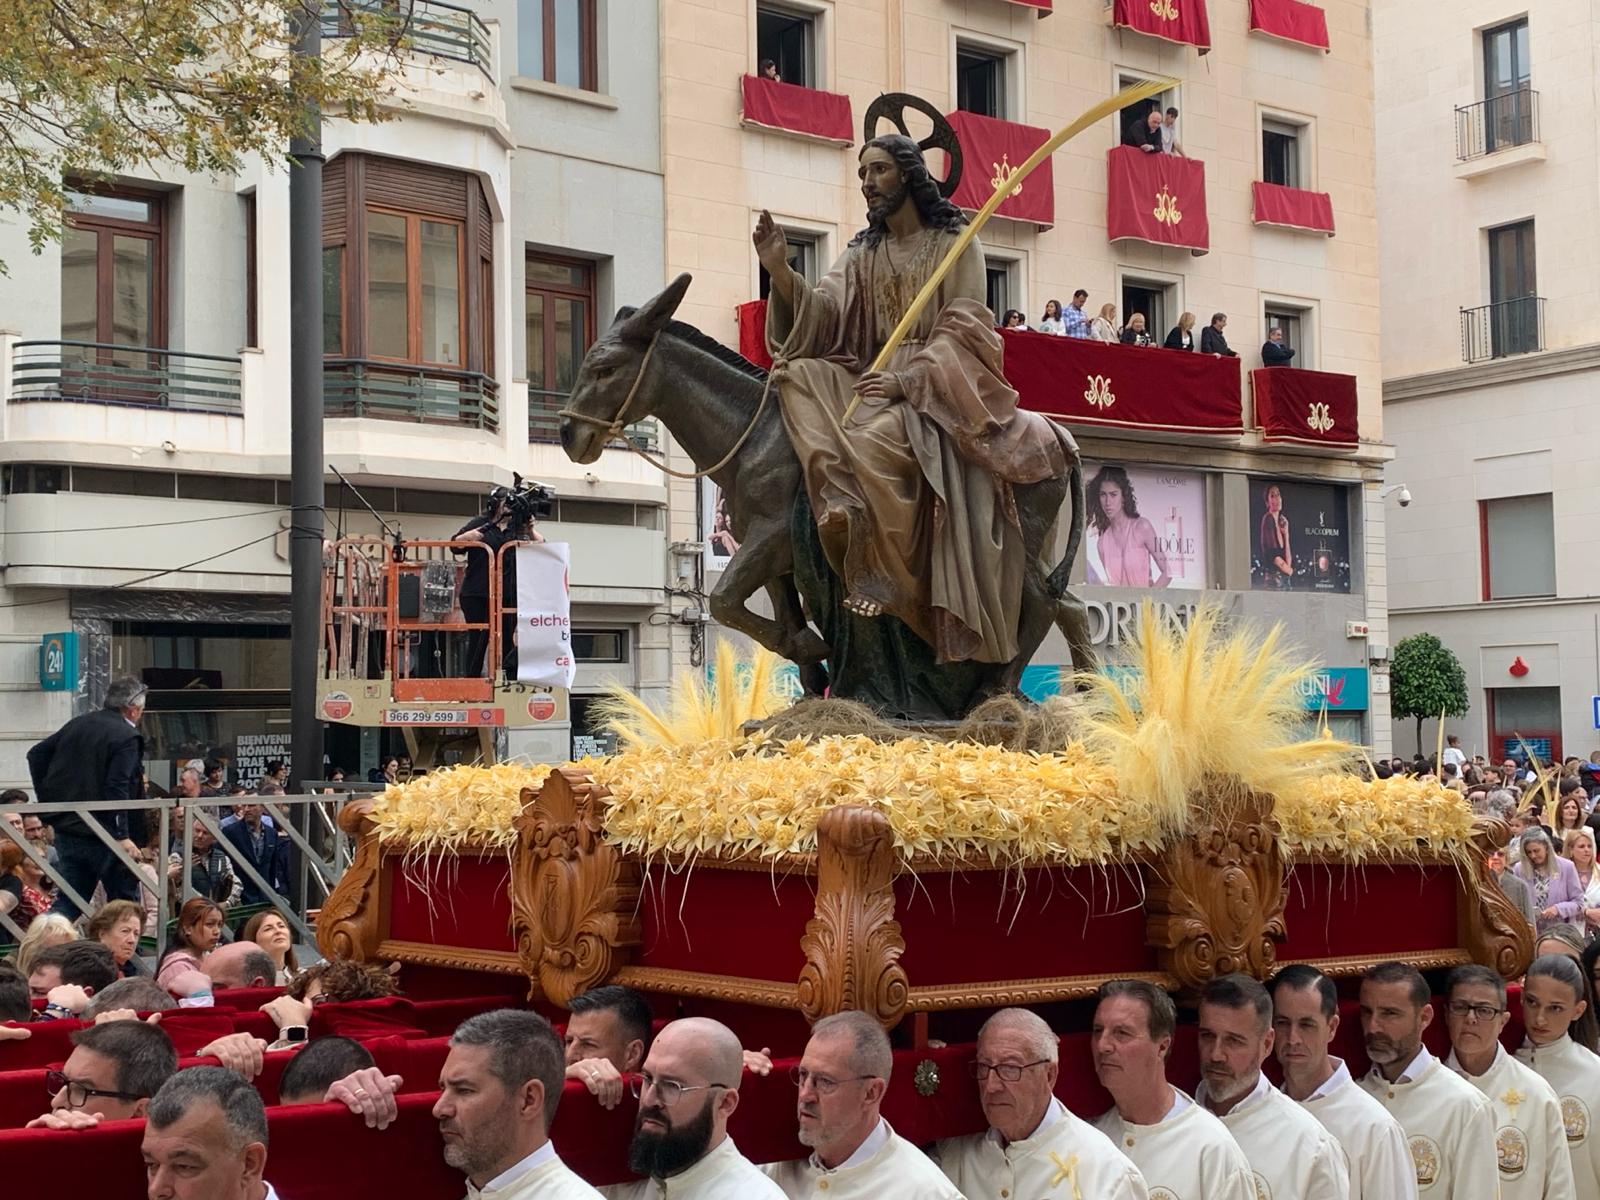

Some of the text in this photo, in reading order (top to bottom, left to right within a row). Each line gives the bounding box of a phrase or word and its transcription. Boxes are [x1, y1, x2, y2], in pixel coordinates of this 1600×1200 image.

[389, 712, 454, 722] 966 299 599
[237, 734, 291, 746] BIENVENI
[237, 756, 265, 768] TRAE
[237, 768, 245, 778] Y
